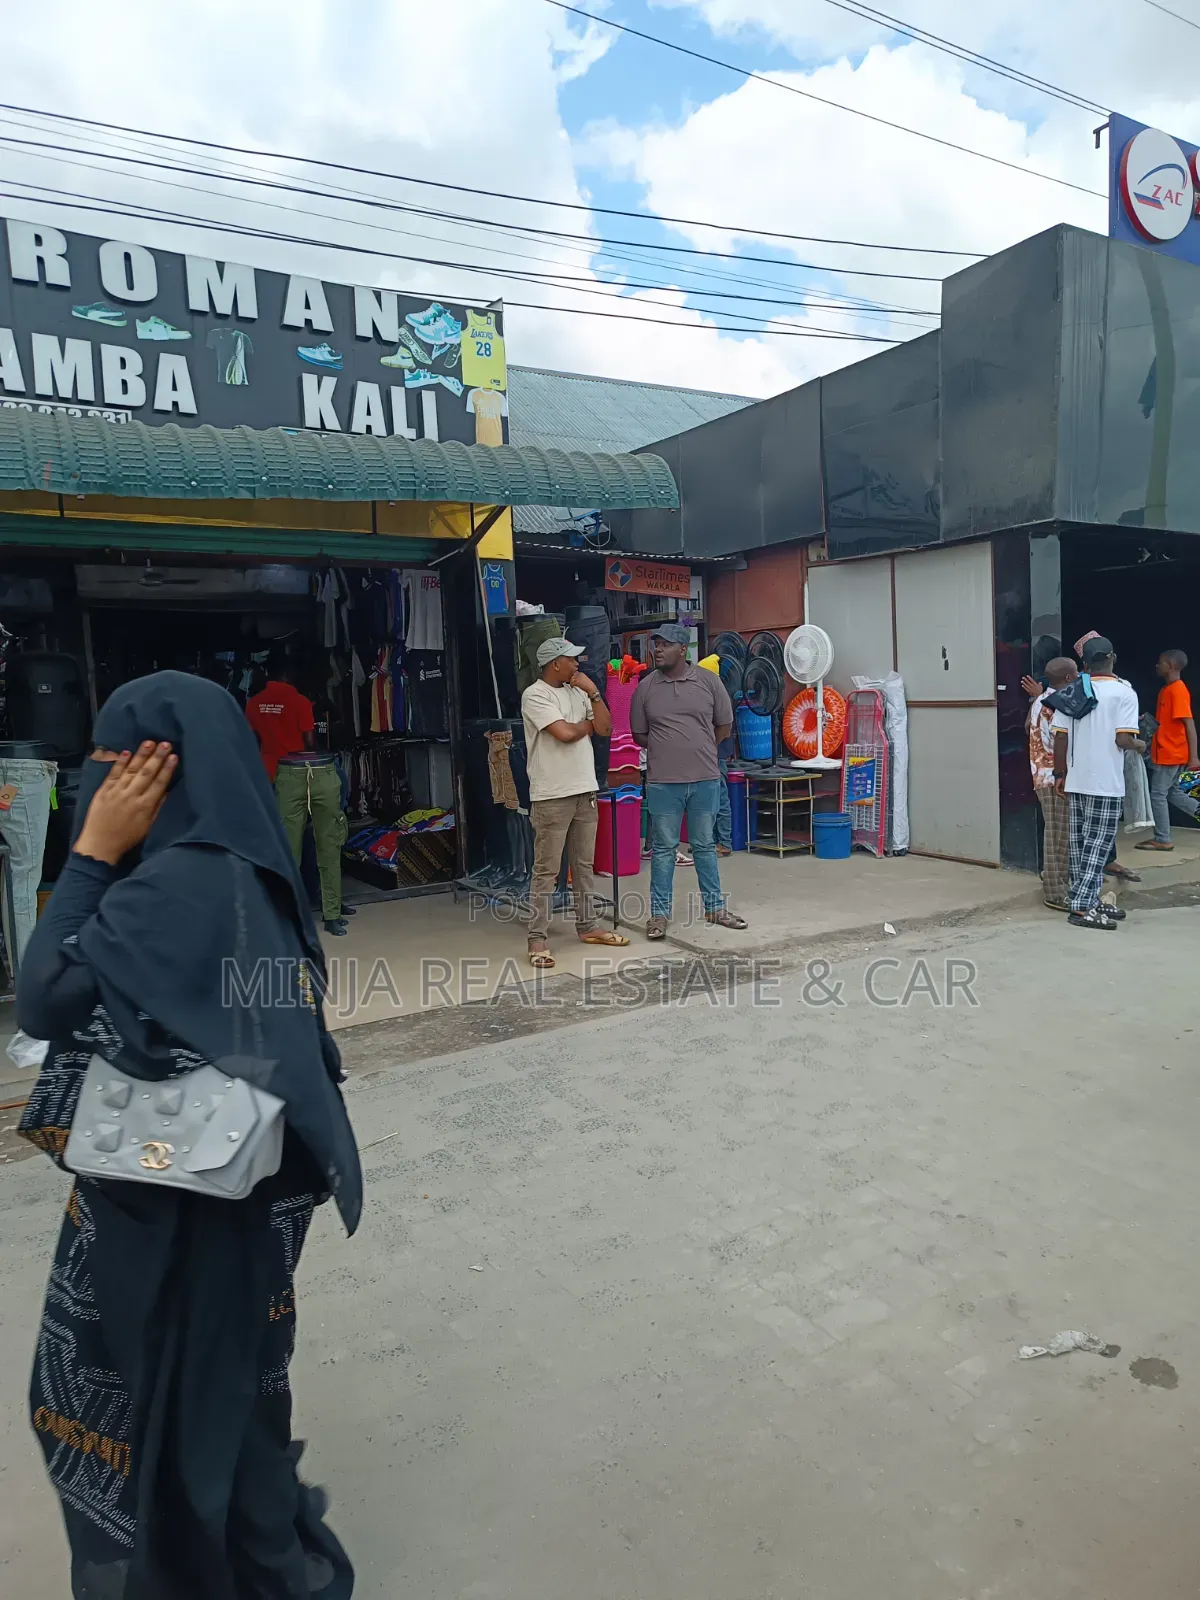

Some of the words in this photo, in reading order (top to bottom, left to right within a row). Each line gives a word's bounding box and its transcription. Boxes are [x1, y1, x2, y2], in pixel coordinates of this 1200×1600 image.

[1152, 184, 1184, 206] ZAC
[6, 218, 399, 342] ROMAN
[475, 341, 492, 357] 28
[0, 327, 198, 415] AMBA
[302, 373, 438, 442] KALI
[635, 565, 690, 584] StarTimes
[646, 581, 680, 592] WAKALA
